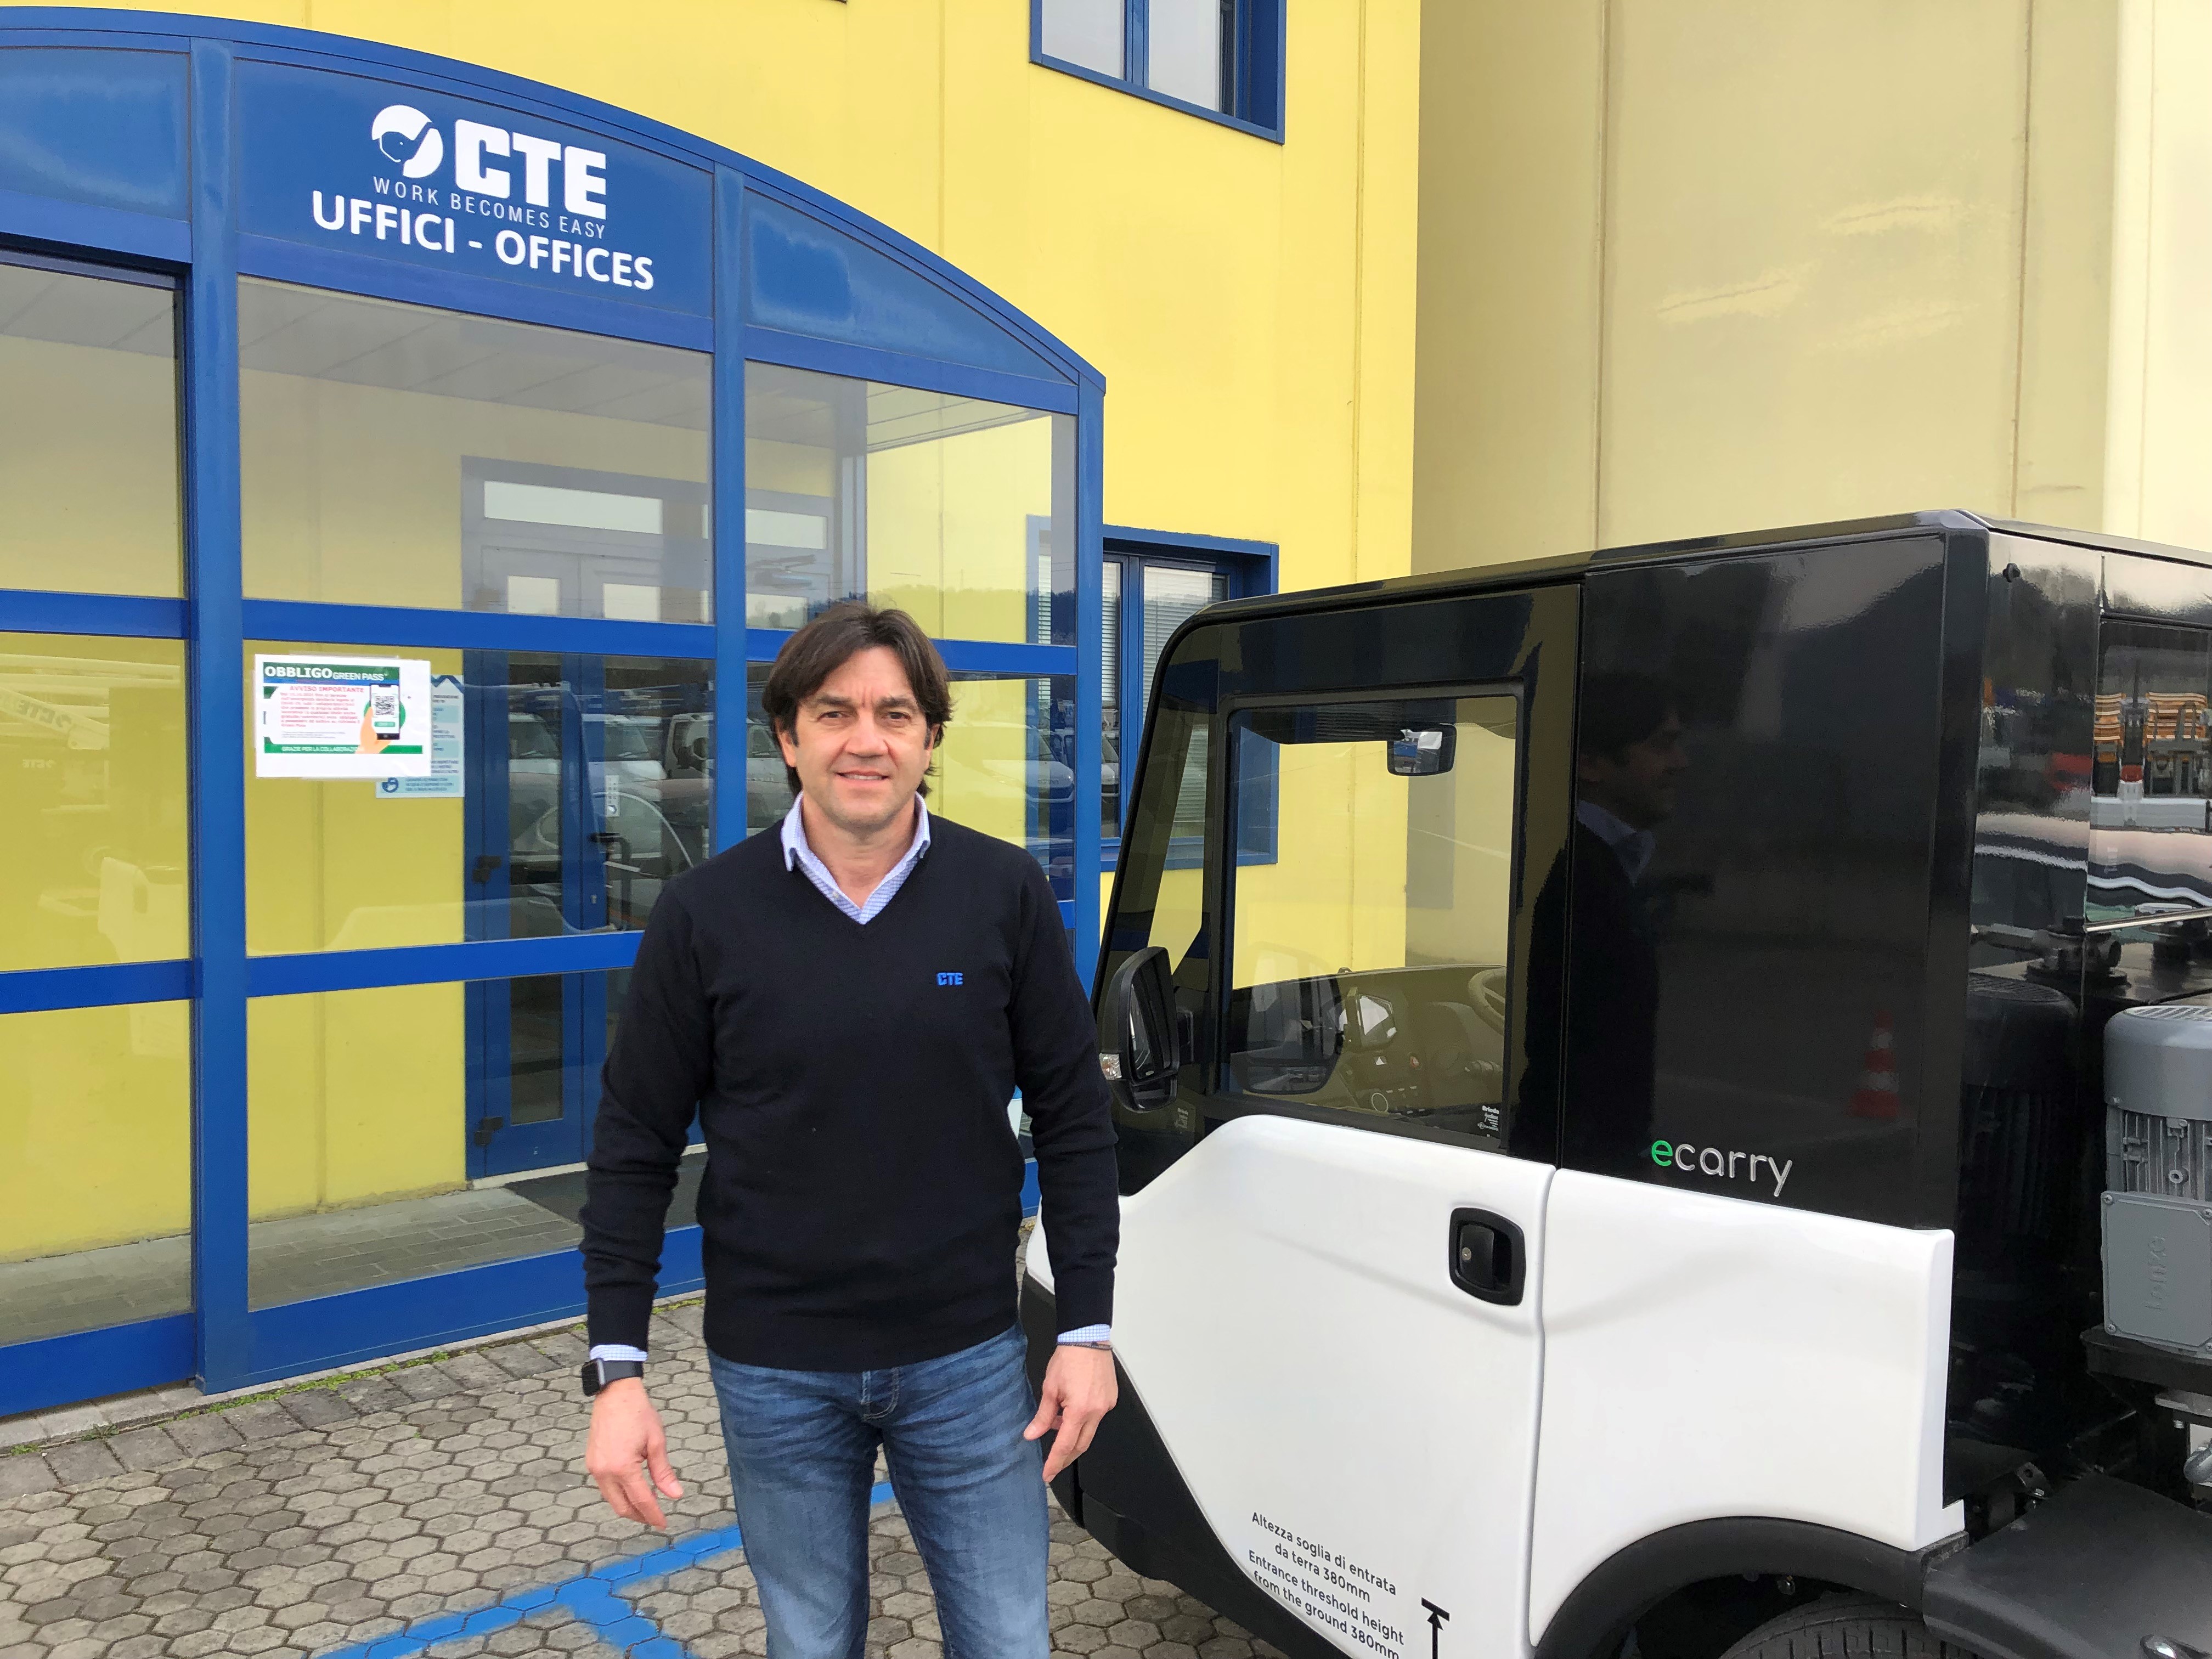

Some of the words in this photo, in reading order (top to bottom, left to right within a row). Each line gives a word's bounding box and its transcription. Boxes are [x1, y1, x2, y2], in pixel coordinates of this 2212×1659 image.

[455, 119, 606, 220] CTE
[312, 190, 455, 253] UFFICI
[495, 230, 654, 290] OFFICES
[373, 176, 439, 206] WORK
[450, 193, 549, 228] BECOMES
[560, 216, 605, 239] EASY
[264, 665, 332, 679] OBBLIGO
[332, 672, 361, 680] GREEN
[362, 673, 384, 681] PASS
[937, 972, 963, 985] CTE
[1651, 1139, 1793, 1197] ecarry
[1252, 1511, 1293, 1543] Altezza
[1296, 1537, 1331, 1562] soglia
[1335, 1554, 1346, 1570] di
[1350, 1564, 1396, 1596] entrata
[1275, 1543, 1289, 1559] da
[1291, 1550, 1320, 1576] terra
[1323, 1567, 1370, 1602] 380mm
[1249, 1549, 1299, 1587] Entrance
[1301, 1578, 1358, 1621] threshold
[1362, 1611, 1404, 1645] height
[1254, 1570, 1280, 1595] from
[1283, 1587, 1302, 1607] the
[1305, 1602, 1347, 1634] ground
[1351, 1625, 1399, 1659] 380mm
